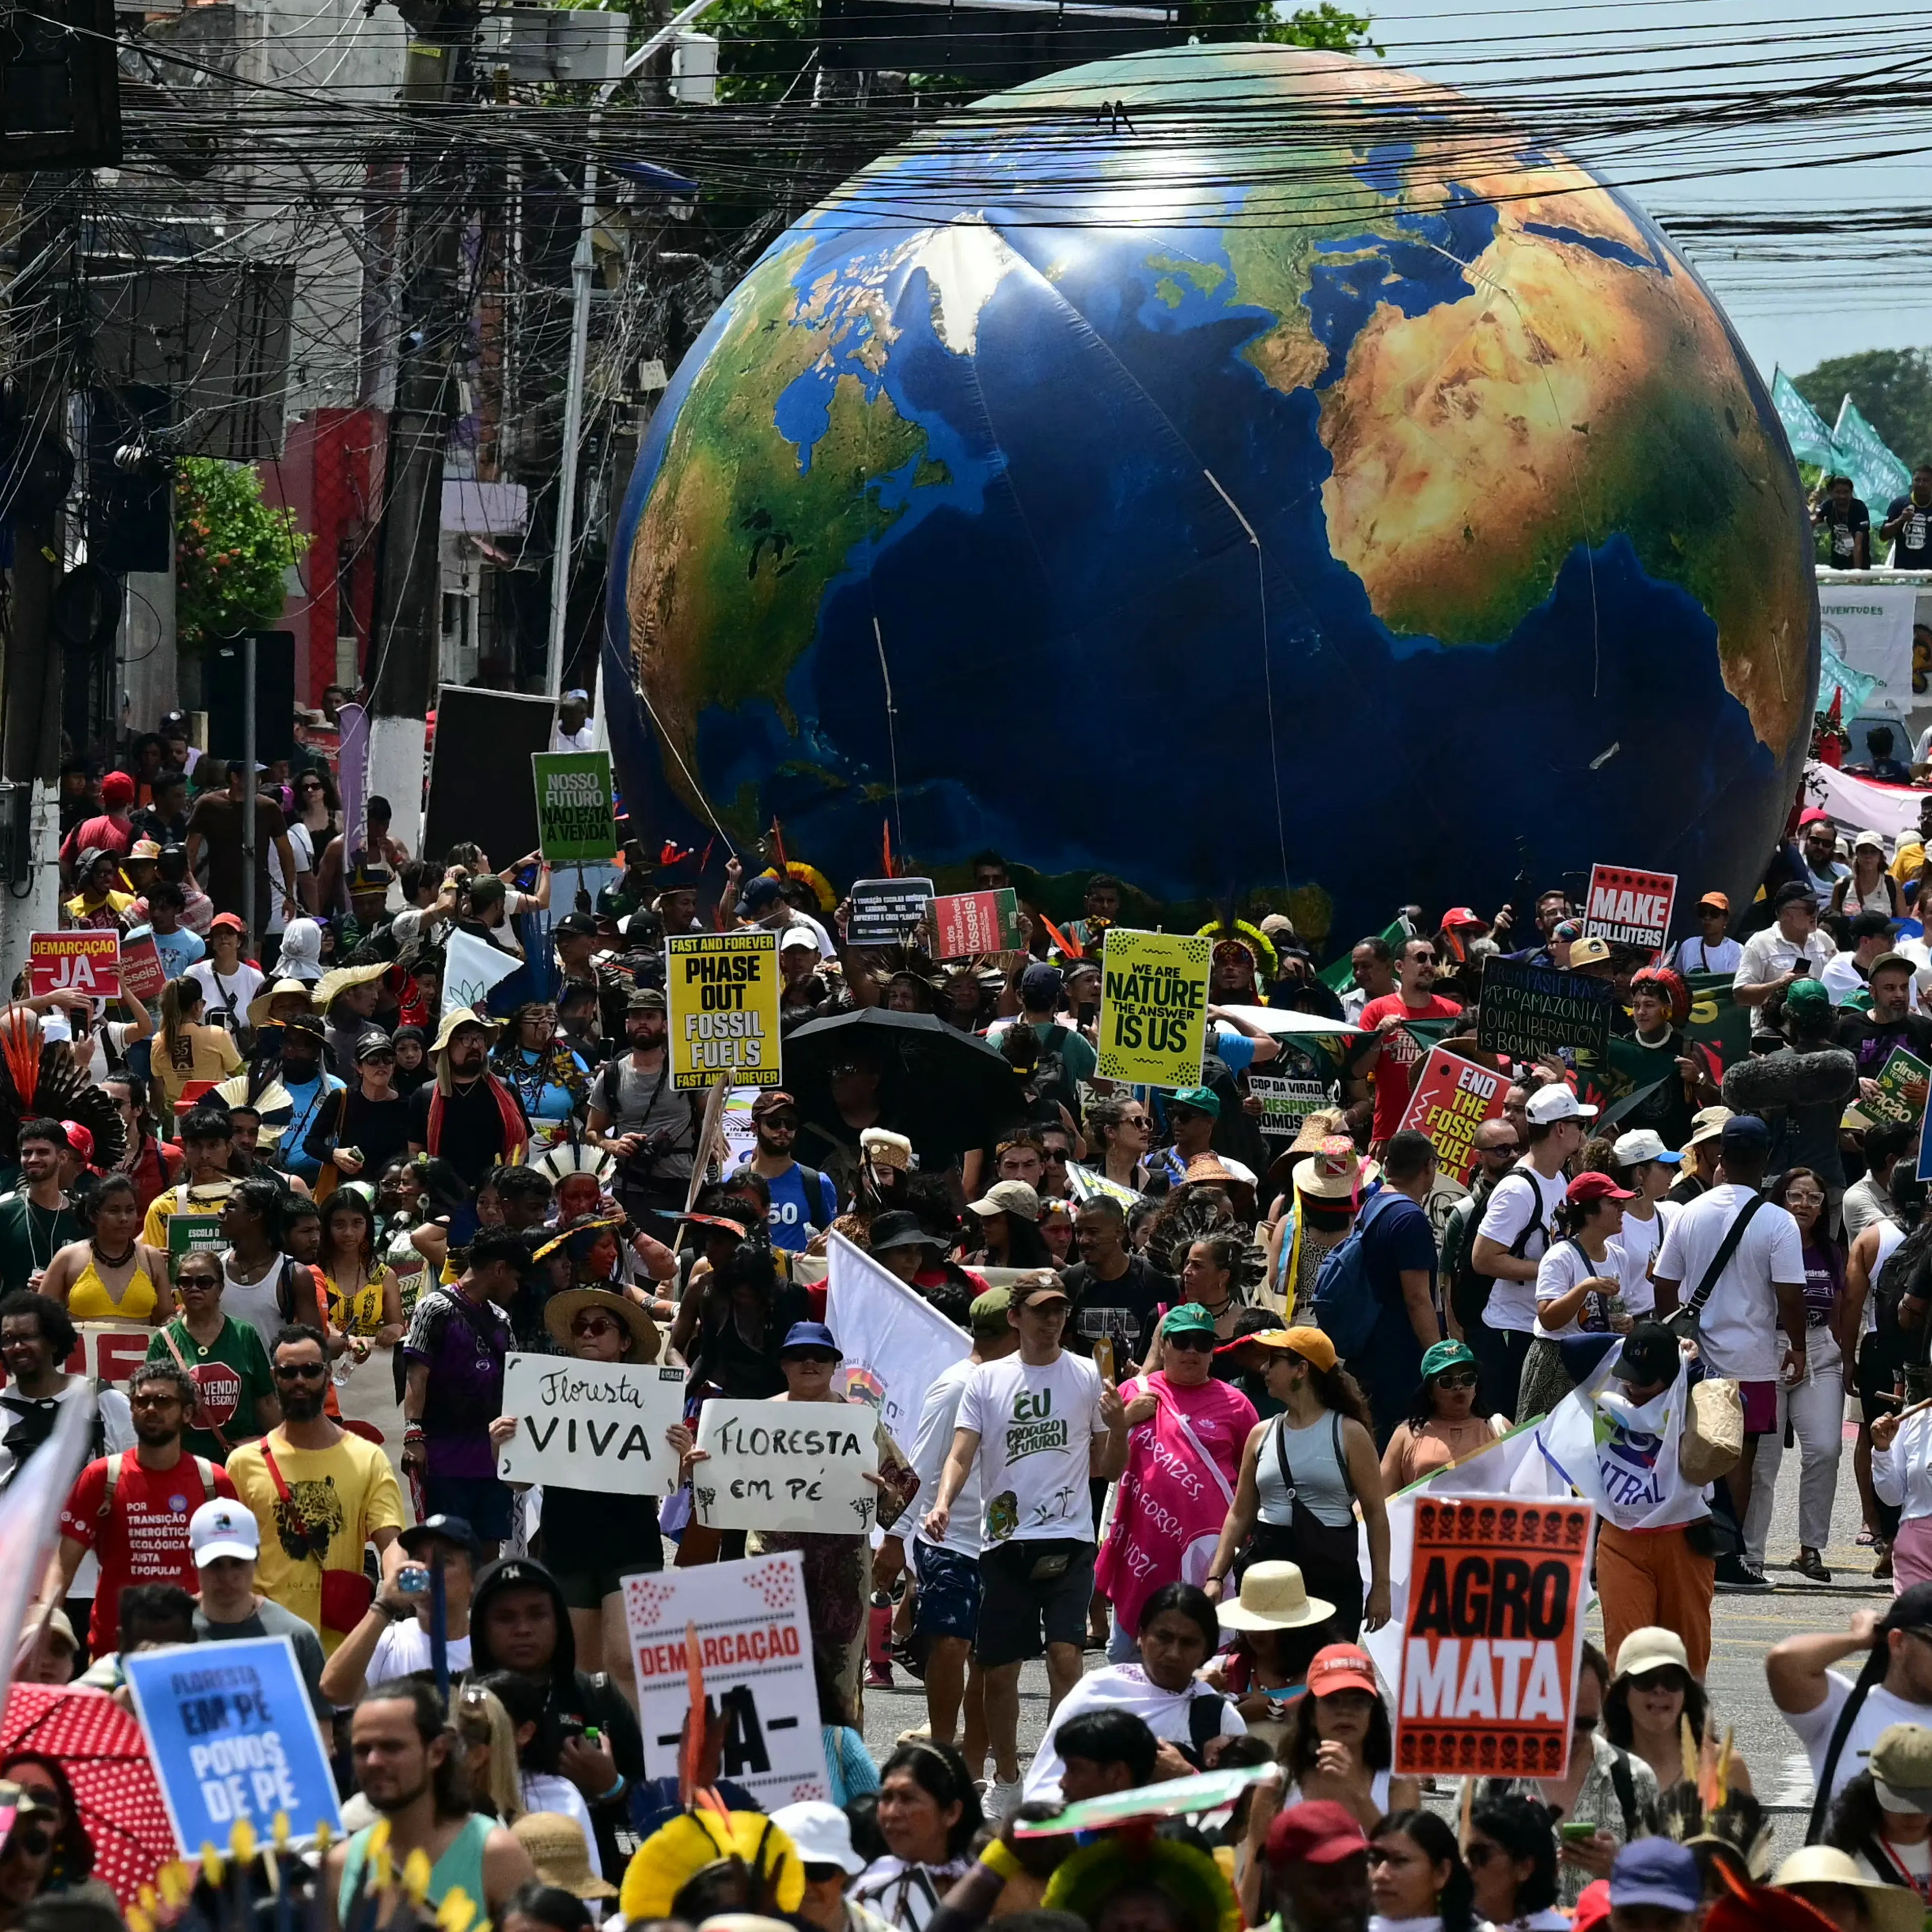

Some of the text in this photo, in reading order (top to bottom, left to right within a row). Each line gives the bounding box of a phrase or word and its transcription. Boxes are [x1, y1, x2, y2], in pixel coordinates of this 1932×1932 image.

[1821, 605, 1884, 615] UVENTUDES
[547, 773, 599, 790] NOSSO
[545, 789, 604, 808] FUTURO
[558, 823, 610, 842] VENDA
[1590, 886, 1668, 928] MAKE
[671, 935, 774, 952] FAST AND FOREVER
[1587, 920, 1663, 947] POLLUTERS
[124, 962, 162, 985] sseis!
[685, 955, 761, 984] PHASE
[1132, 963, 1181, 979] WE ARE
[701, 984, 747, 1011] OUT
[1106, 971, 1205, 1010] NATURE
[1505, 987, 1602, 1022] TO AMAZONIA
[1112, 1001, 1195, 1021] THE ANSWER
[684, 1011, 765, 1041] FOSSIL
[1114, 1014, 1188, 1054] IS US
[1486, 1007, 1602, 1047] OUR LIBERATION
[690, 1039, 761, 1070] FUELS
[1480, 1031, 1551, 1057] IS BOUND
[677, 1074, 704, 1087] FAST
[736, 1071, 778, 1085] OREVER
[1251, 1078, 1322, 1095] COP DA VIRAD
[1458, 1066, 1497, 1100] END
[1451, 1088, 1489, 1122] THE
[1425, 1104, 1478, 1146] FOSS
[203, 1380, 238, 1396] VENDA
[539, 1367, 645, 1409] Floresta
[1014, 1388, 1051, 1421] EU
[524, 1415, 652, 1462] VIVA
[713, 1416, 861, 1457] FLORESTA
[1006, 1420, 1060, 1448] PRODUZO
[785, 1468, 825, 1502] PÉ
[126, 1502, 147, 1512] POR
[127, 1512, 187, 1526] TRANSIÇÃO
[128, 1525, 190, 1538] ENERGÉTICA
[130, 1539, 186, 1551] ECOLÓGICA
[131, 1552, 160, 1563] JUSTA
[1410, 1556, 1571, 1640] AGRO
[1401, 1637, 1565, 1722] MATA
[189, 1730, 286, 1779] POVOS
[201, 1762, 300, 1824] DE PÉ
